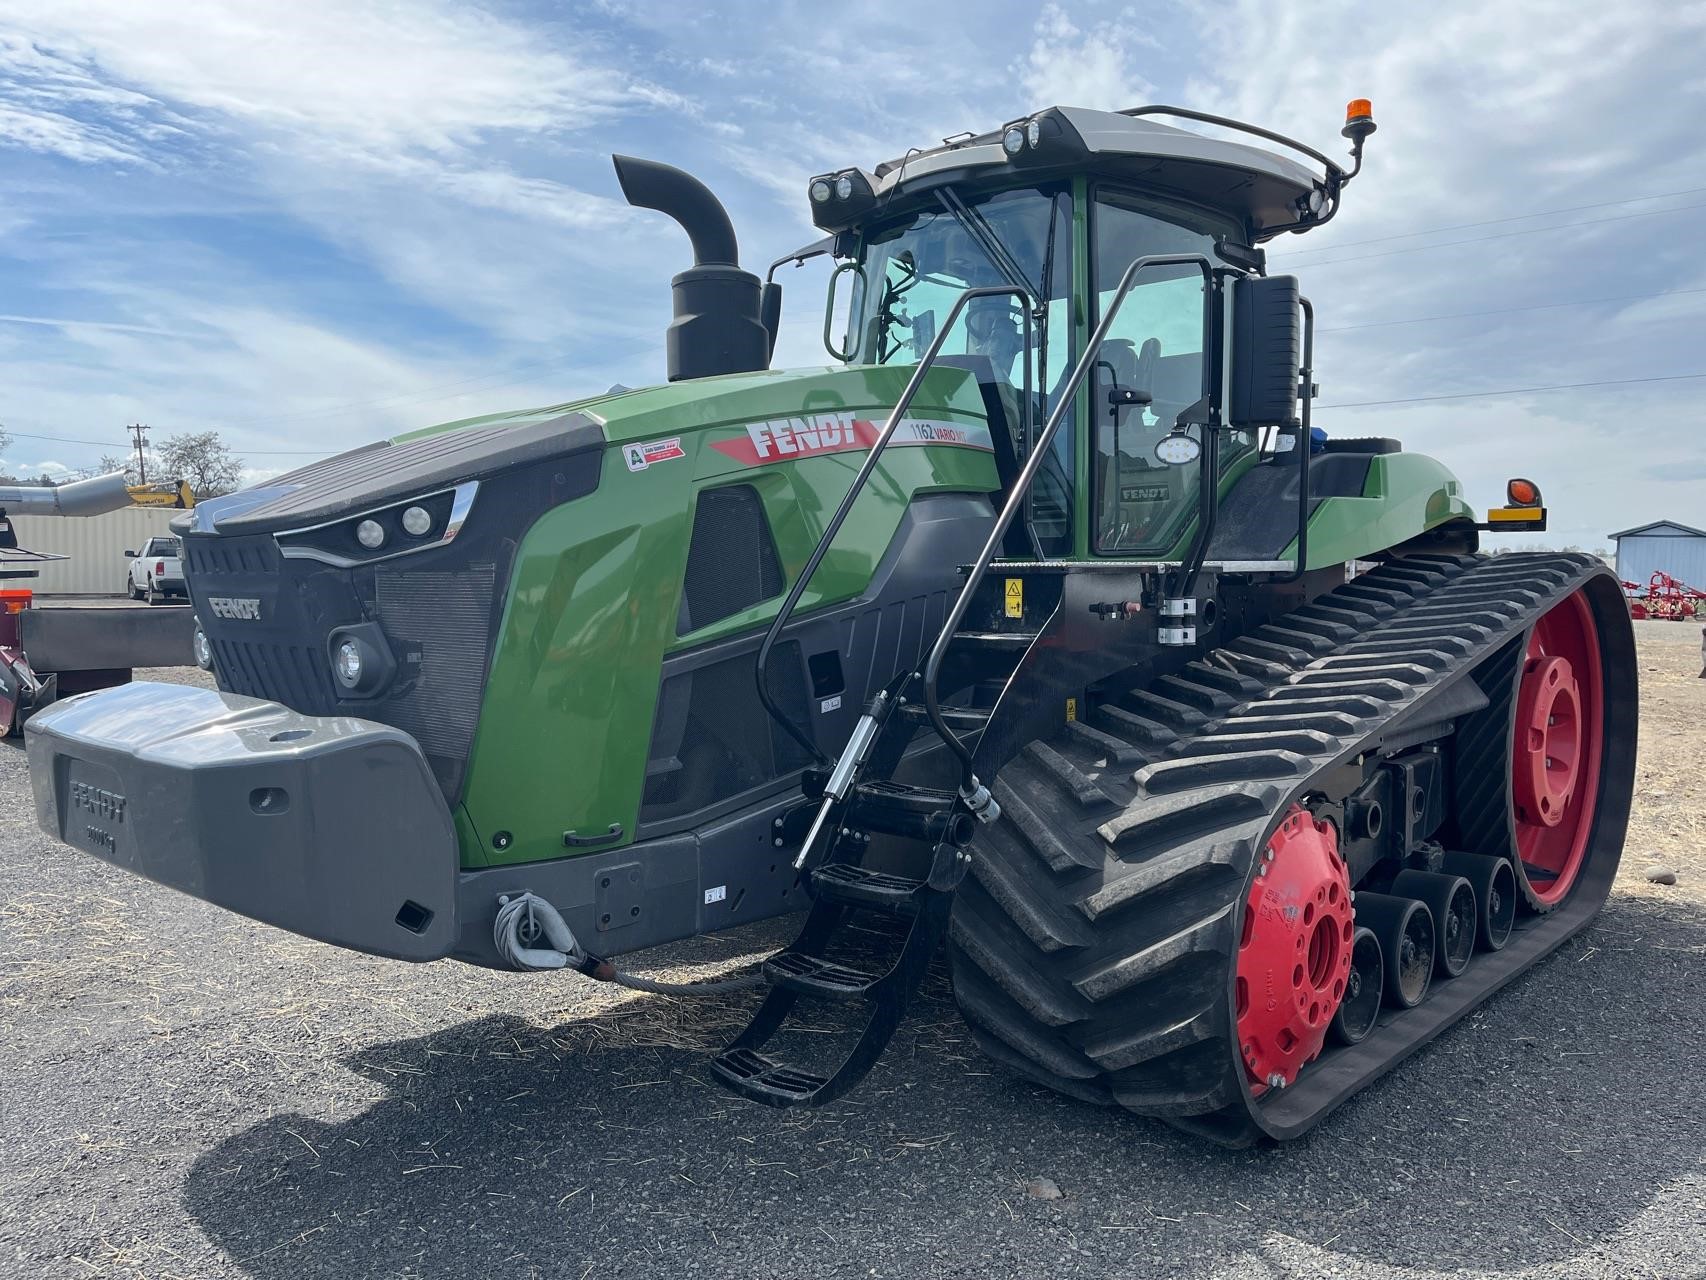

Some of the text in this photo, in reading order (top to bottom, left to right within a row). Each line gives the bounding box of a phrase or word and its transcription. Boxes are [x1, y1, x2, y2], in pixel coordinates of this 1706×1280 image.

[745, 411, 855, 457] FENDT
[911, 424, 934, 440] 1162
[934, 428, 955, 440] VARIO
[1122, 488, 1168, 499] FENDT
[208, 598, 261, 620] FENDT
[70, 781, 126, 823] FENDT
